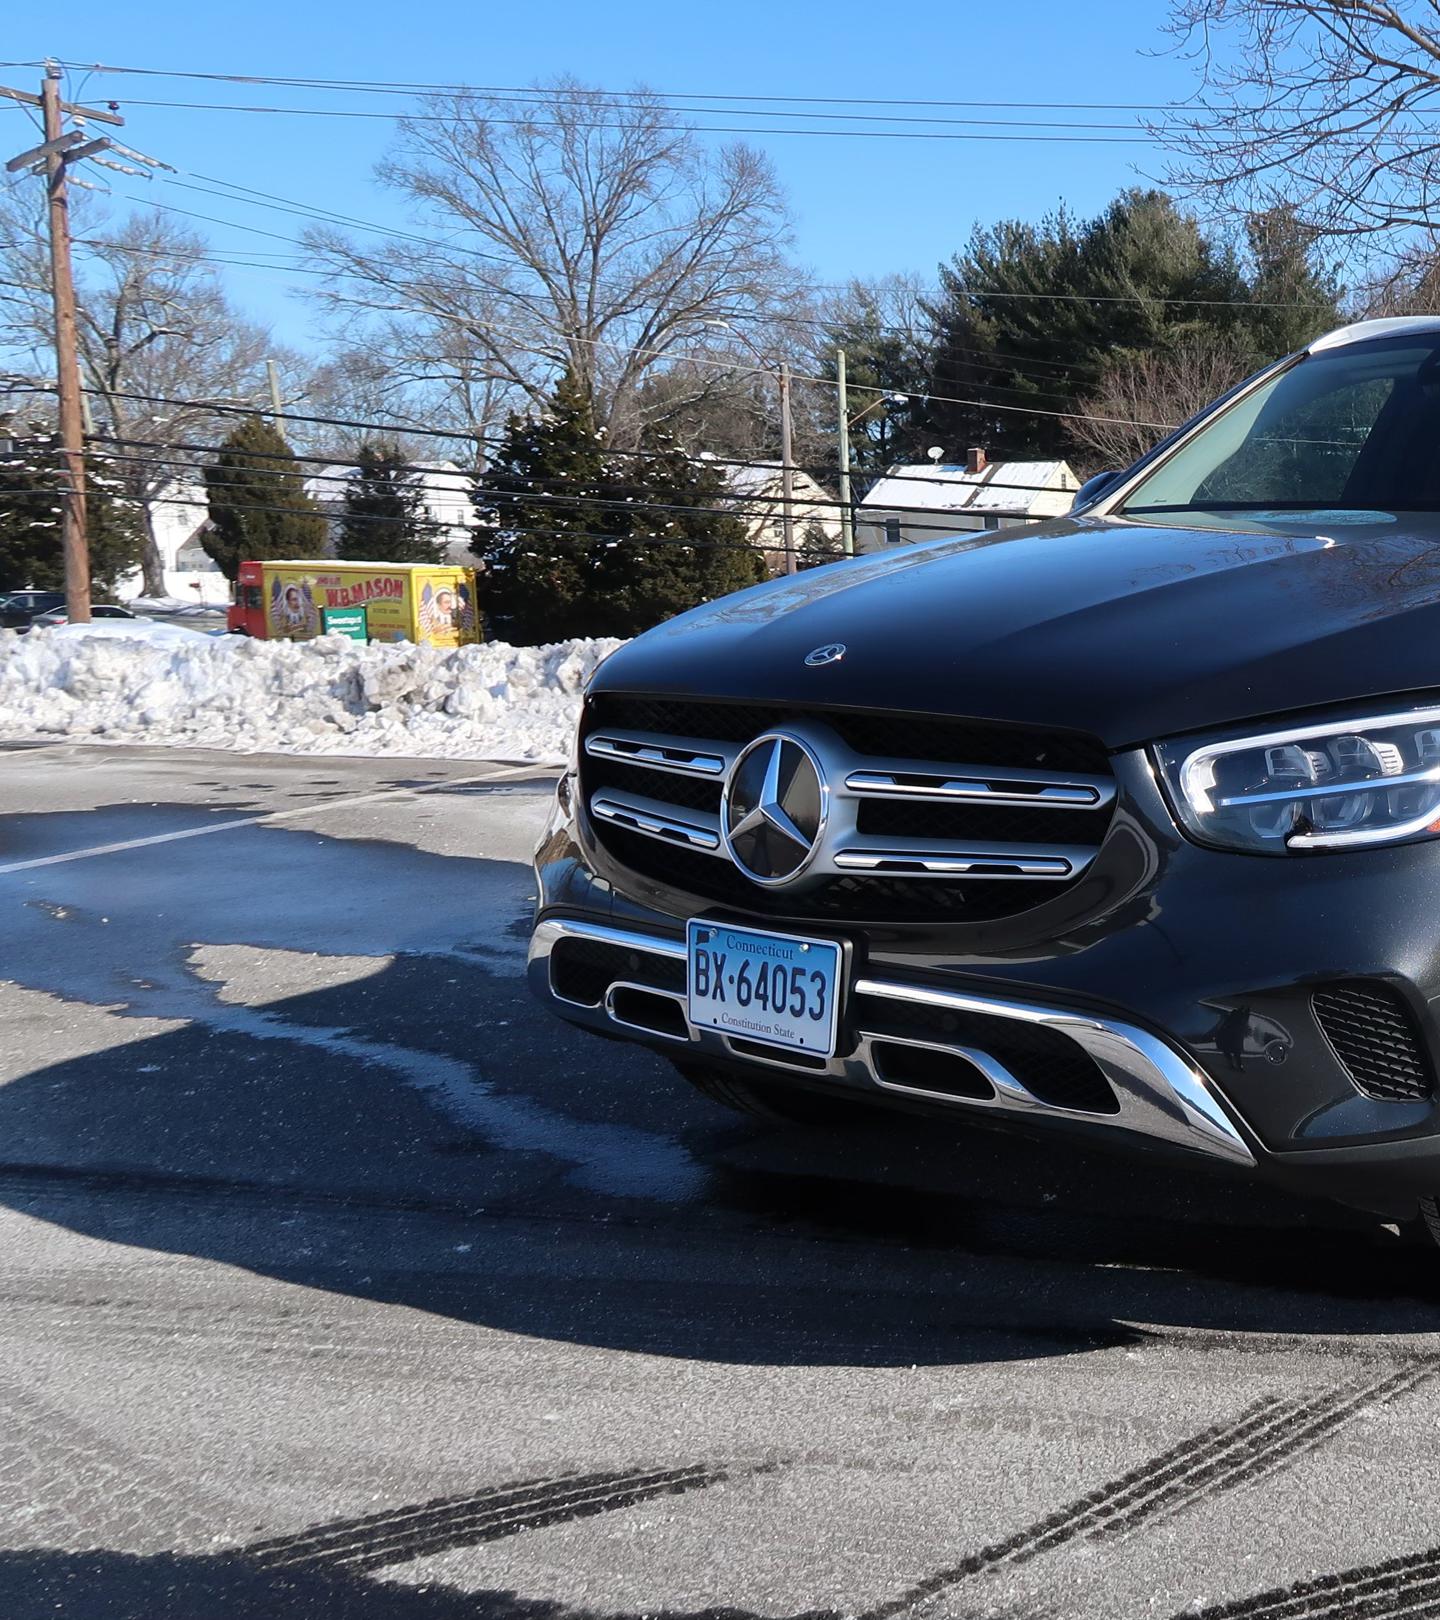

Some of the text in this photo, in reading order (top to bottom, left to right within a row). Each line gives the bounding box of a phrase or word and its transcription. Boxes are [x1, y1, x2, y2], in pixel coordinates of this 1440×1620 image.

[727, 934, 794, 961] Connecticut
[721, 1012, 795, 1039] Constitution State
